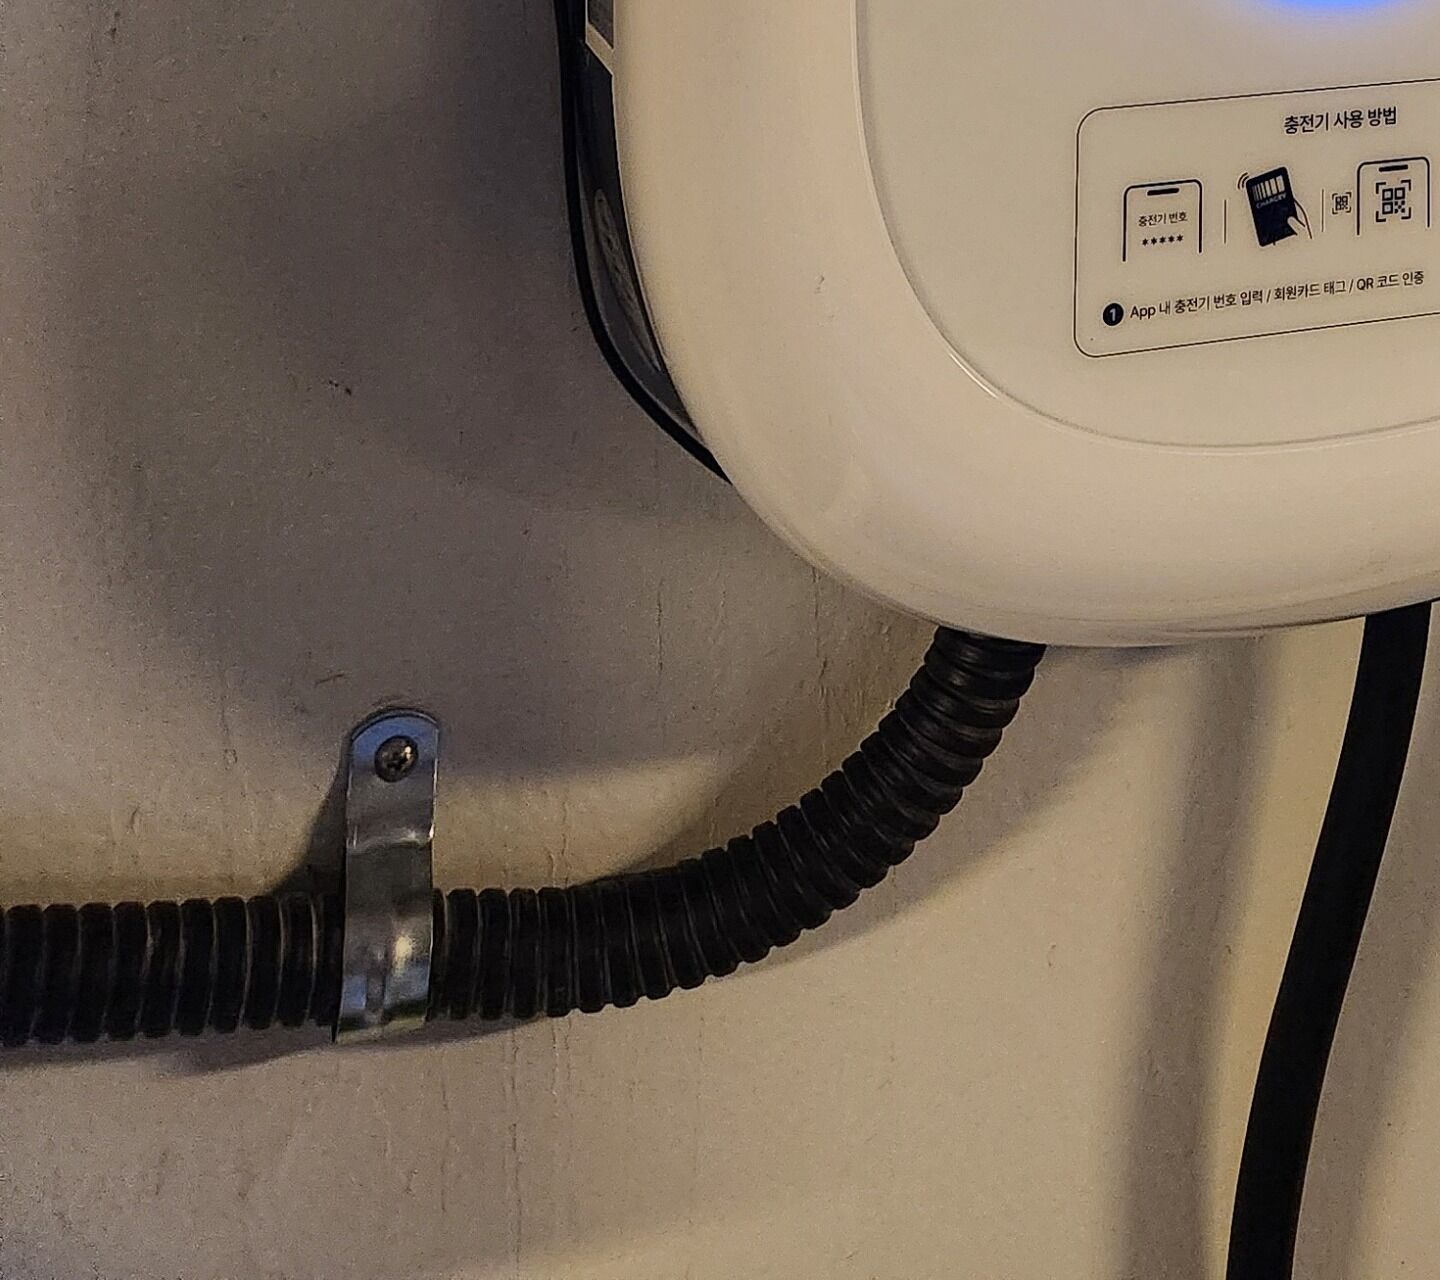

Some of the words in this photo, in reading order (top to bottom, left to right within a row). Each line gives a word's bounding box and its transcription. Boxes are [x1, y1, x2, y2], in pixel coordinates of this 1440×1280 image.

[1283, 111, 1330, 135] 충전기
[1333, 109, 1364, 132] 사용
[1366, 105, 1398, 129] 방법
[1138, 213, 1167, 227] 충전기
[1168, 211, 1188, 225] 번호
[1130, 303, 1156, 320] App
[1159, 299, 1172, 316] 내
[1174, 293, 1211, 315] 충전기
[1213, 291, 1237, 311] 번호
[1239, 287, 1264, 308] 입력
[1273, 280, 1320, 303] 회원카드
[1322, 278, 1347, 297] 태그
[1356, 276, 1374, 292] QR
[1376, 273, 1400, 290] 코드
[1401, 270, 1425, 288] 인증
